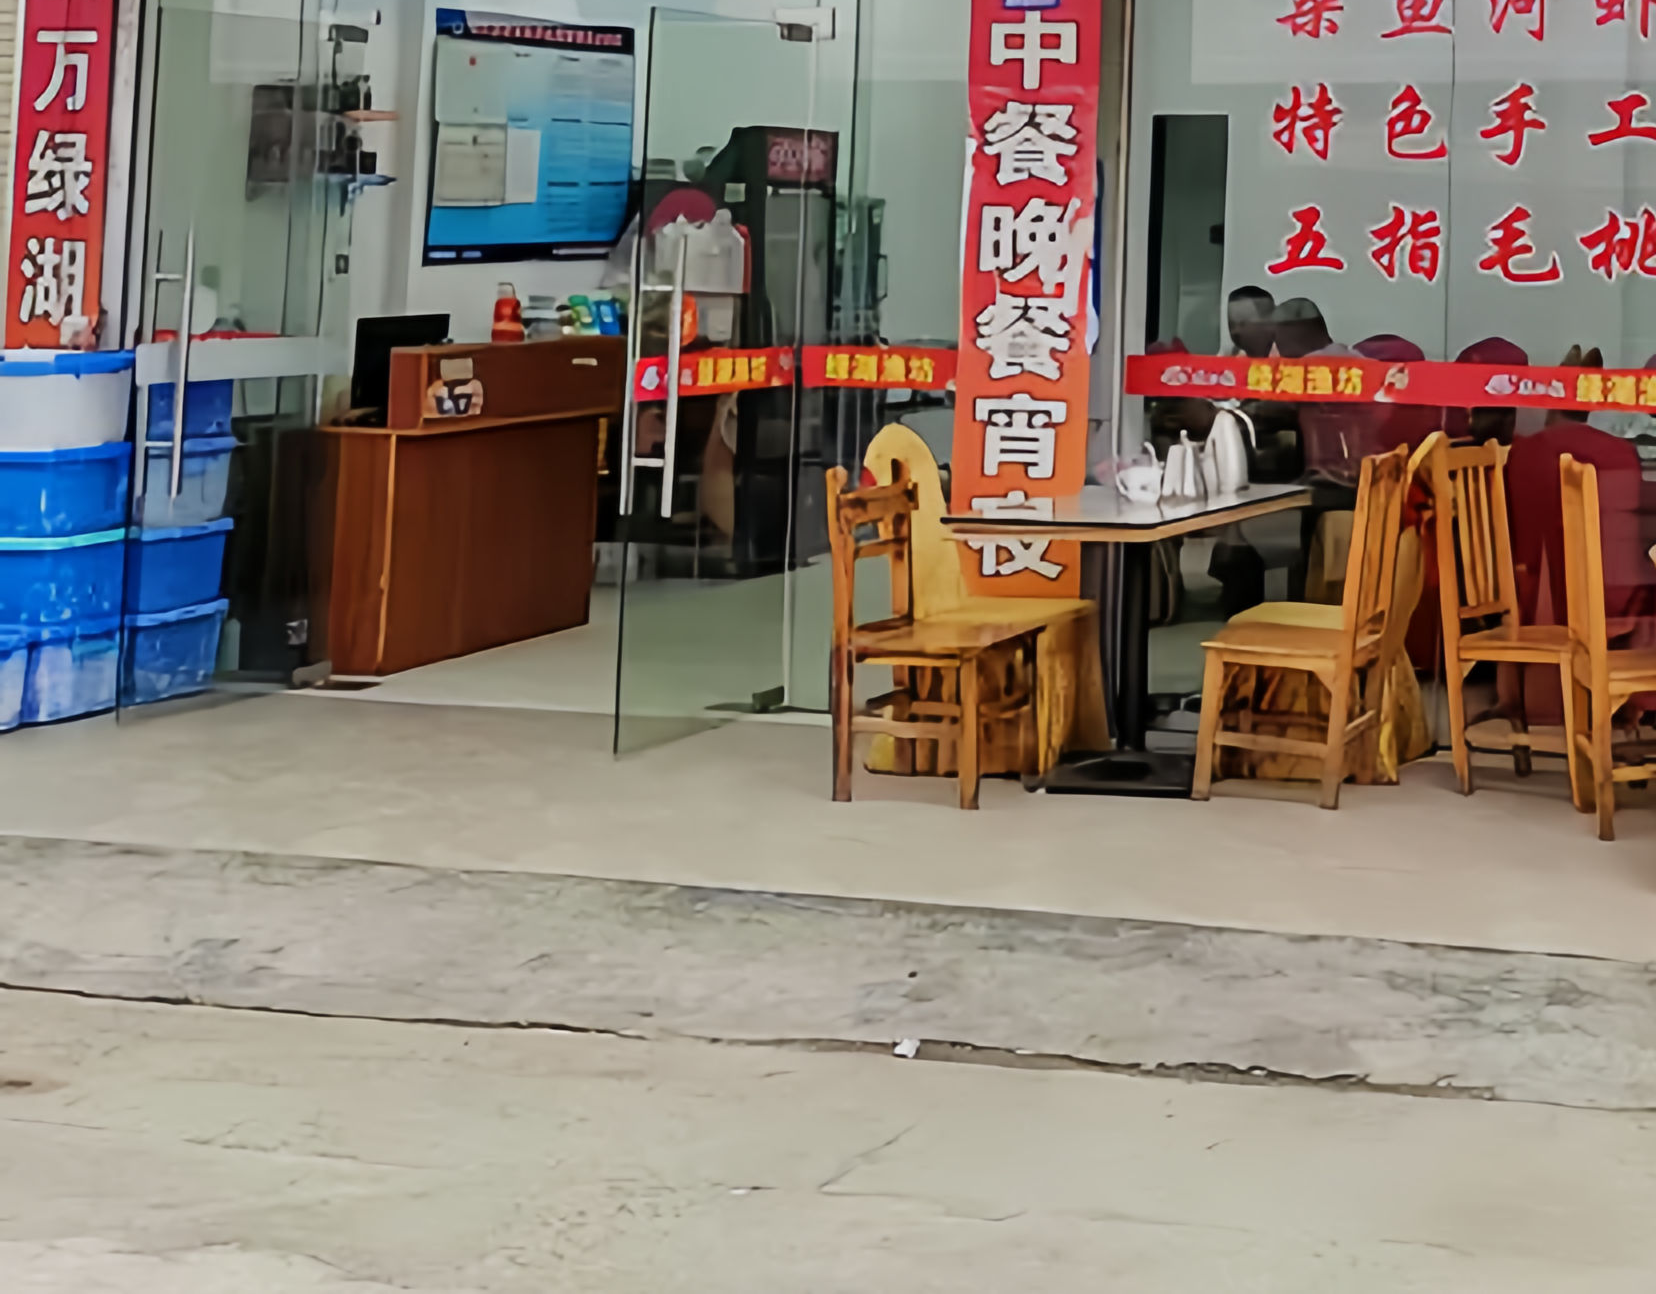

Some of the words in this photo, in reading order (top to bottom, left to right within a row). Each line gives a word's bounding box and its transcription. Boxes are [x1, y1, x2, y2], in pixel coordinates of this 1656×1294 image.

[19, 30, 98, 326] 万绿湖
[967, 10, 1079, 581] 中餐晚餐宵夜
